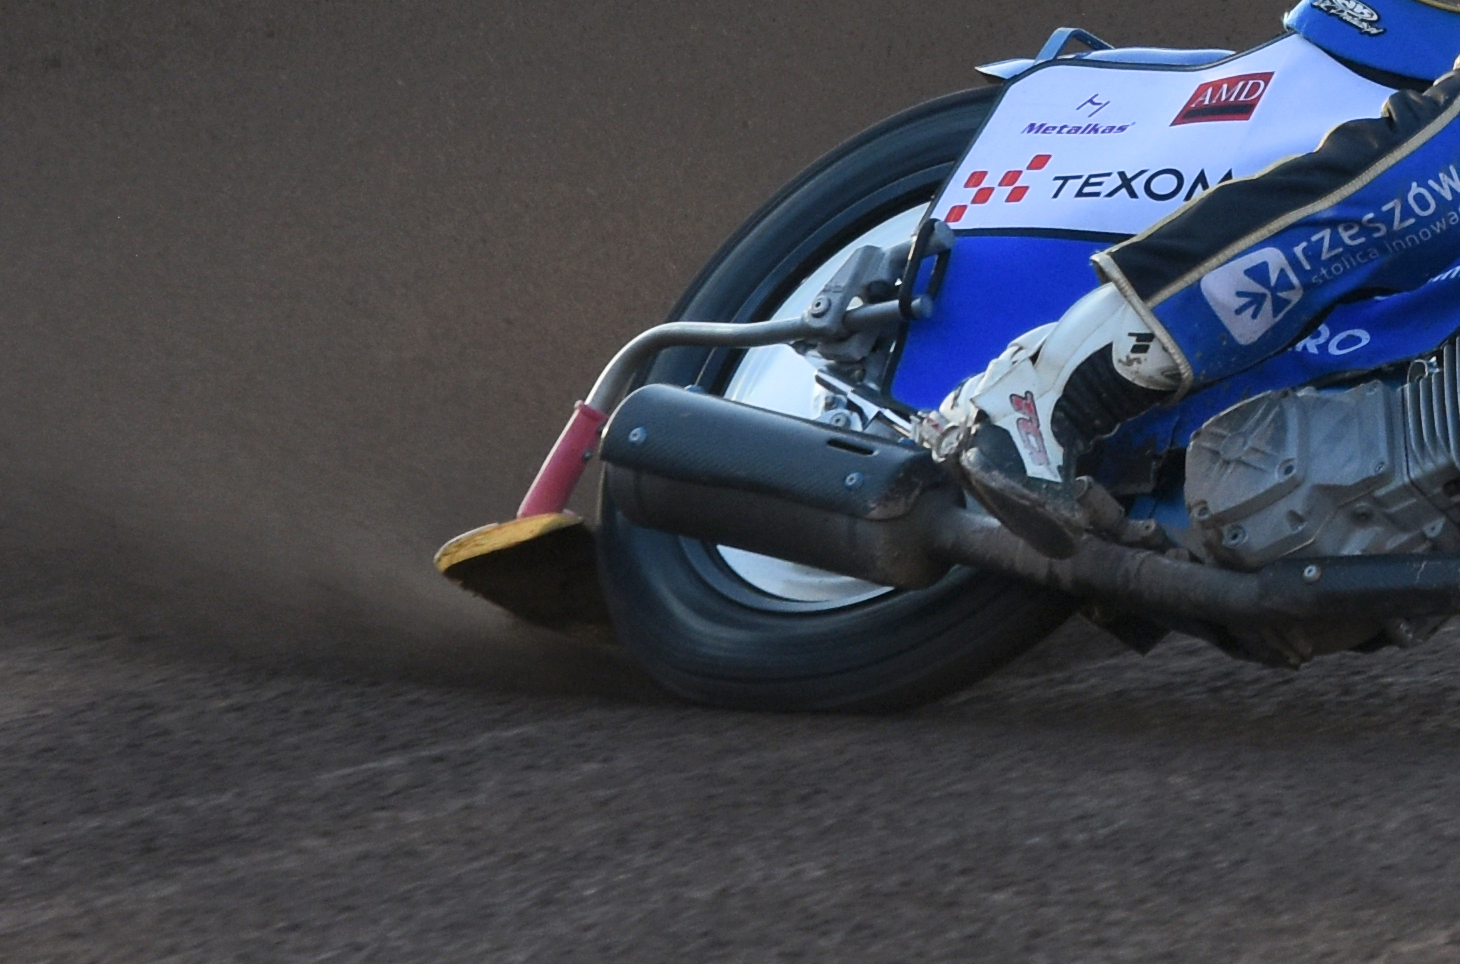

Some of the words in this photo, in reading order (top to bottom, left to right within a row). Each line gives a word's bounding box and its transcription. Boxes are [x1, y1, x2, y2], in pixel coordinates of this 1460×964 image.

[1191, 79, 1266, 108] AMD
[1021, 122, 1131, 135] Metalkas
[1312, 246, 1380, 286] stolica
